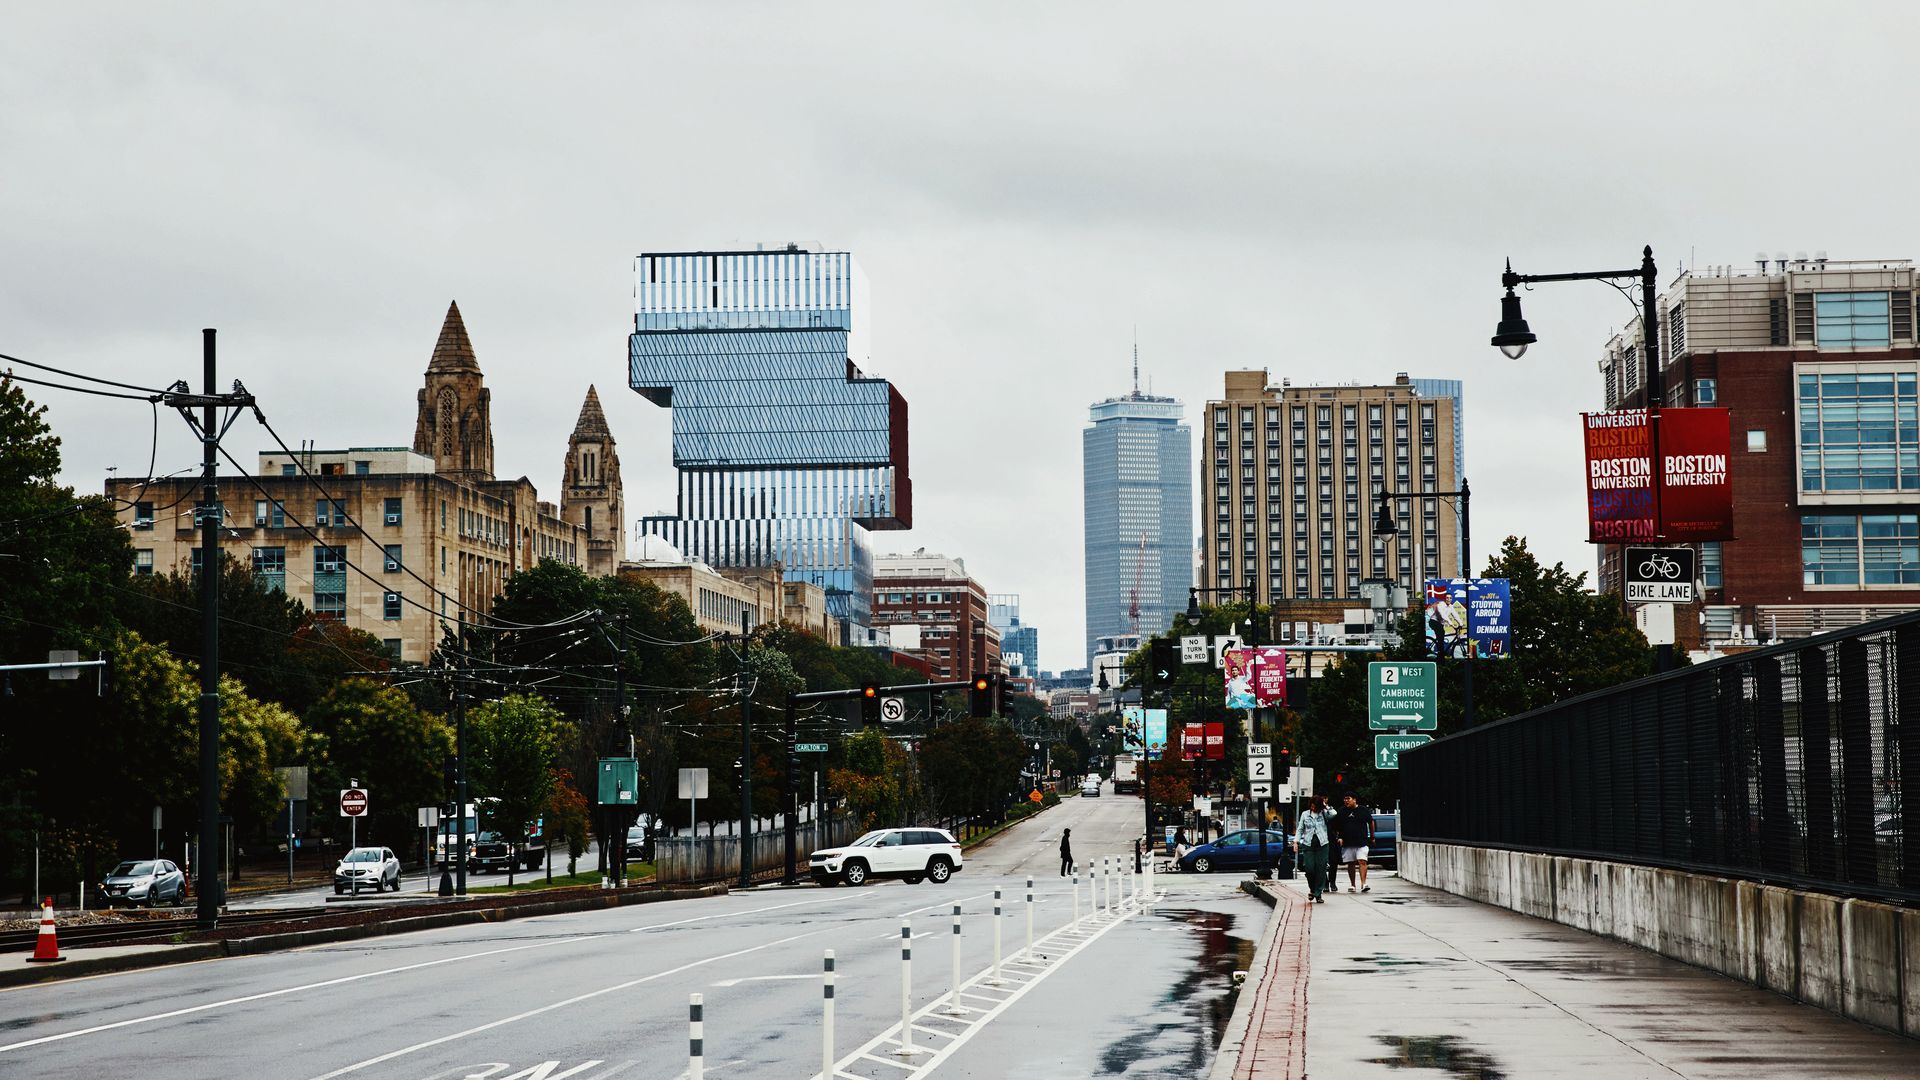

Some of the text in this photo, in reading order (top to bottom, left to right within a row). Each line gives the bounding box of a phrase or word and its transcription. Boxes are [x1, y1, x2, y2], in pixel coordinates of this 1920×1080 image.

[1588, 414, 1647, 428] UNIVERSITY
[1589, 427, 1648, 446] BOSTON
[1591, 445, 1649, 458] UNIVERSITY
[1591, 457, 1650, 477] BOSTON
[1665, 455, 1726, 474] BOSTON
[1592, 475, 1651, 489] UNIVERSITY
[1666, 473, 1726, 486] UNIVERSITY
[1593, 489, 1652, 507] BOSTON
[1595, 519, 1653, 537] BOSTON
[1629, 585, 1690, 598] BIKE LANE
[1471, 600, 1503, 608] STUDYING
[1475, 609, 1501, 617] ABROAD
[1490, 617, 1498, 625] IN
[1476, 625, 1508, 634] DENMARK
[1386, 667, 1422, 682] 2 WEST
[1381, 688, 1425, 697] CAMBRIDGE
[1381, 700, 1424, 709] ARLINGTON
[1255, 762, 1265, 775] 2
